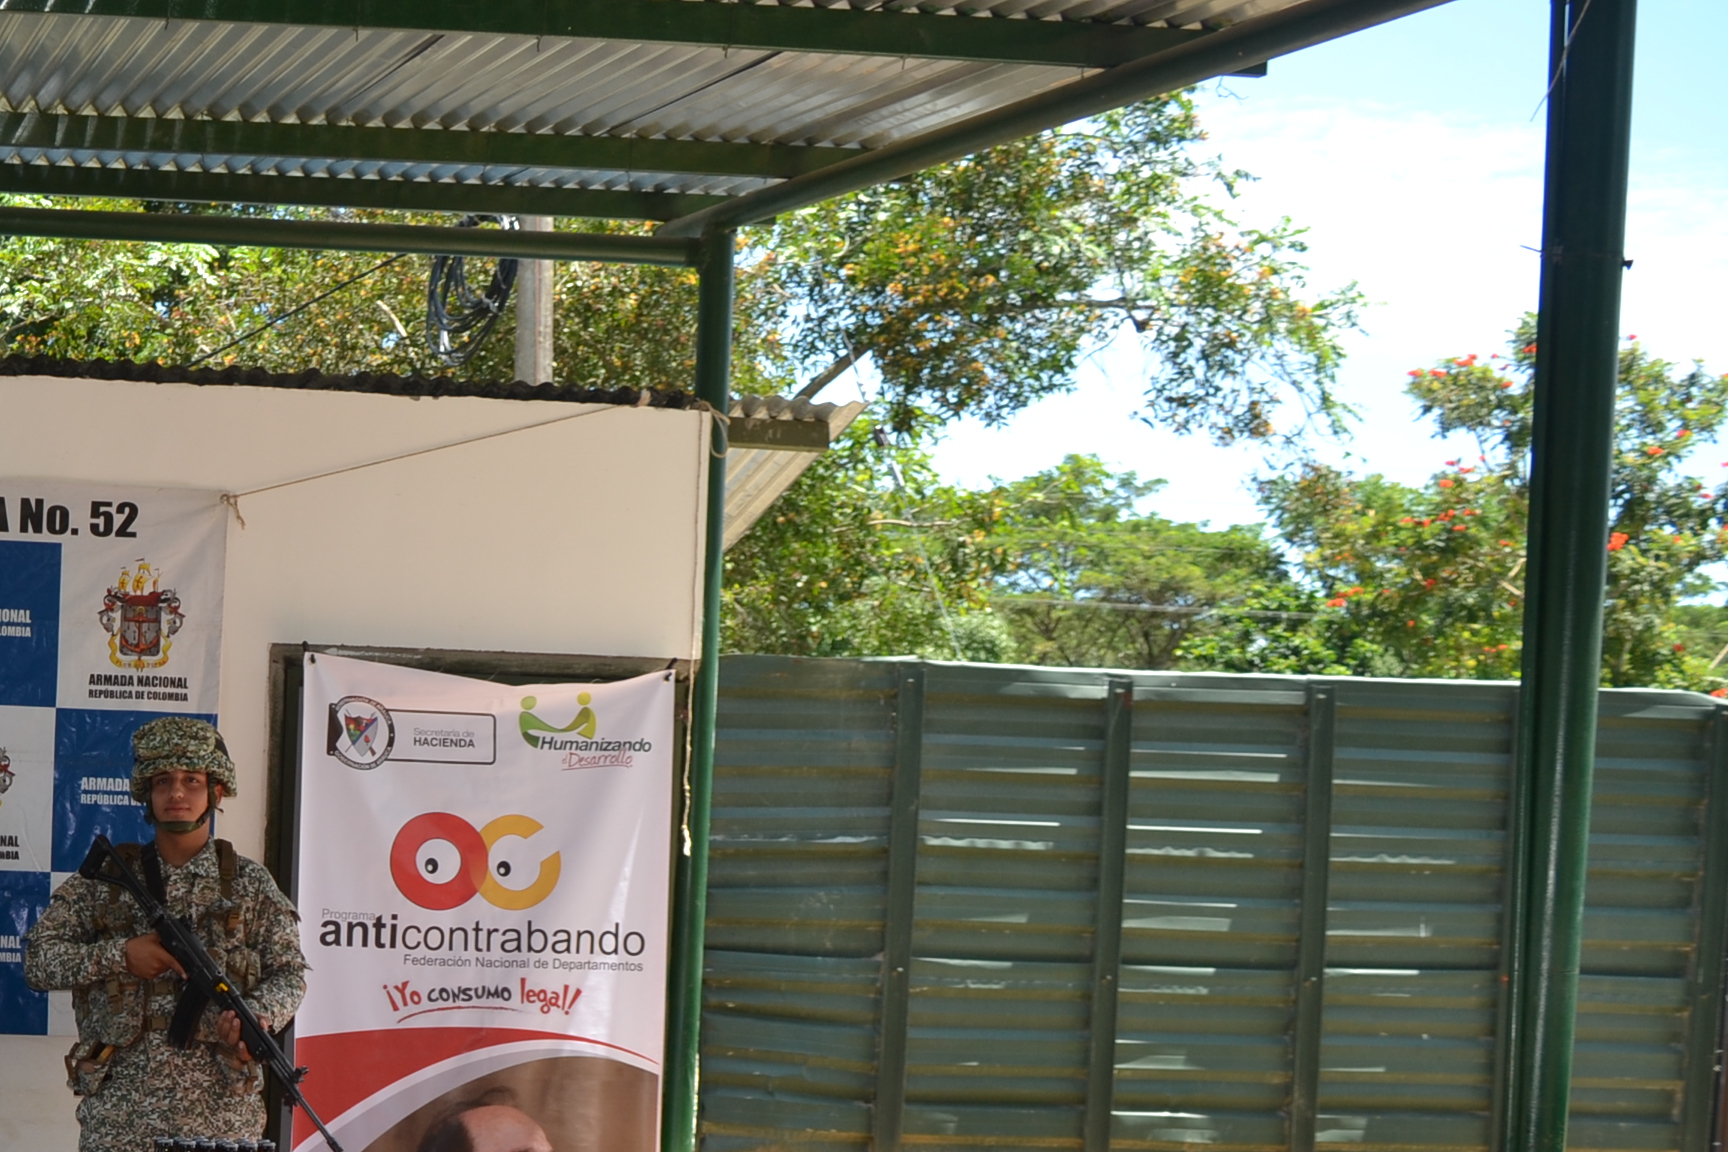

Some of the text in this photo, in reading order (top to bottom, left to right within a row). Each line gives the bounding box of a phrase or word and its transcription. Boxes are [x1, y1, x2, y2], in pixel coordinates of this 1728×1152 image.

[19, 498, 79, 536] No.
[89, 500, 139, 538] 52
[88, 673, 188, 689] ARMADA NACIONAL
[88, 688, 189, 702] REPÚBLICA DE COLOMBIA
[462, 729, 475, 738] de
[413, 736, 475, 749] HACIENDA
[539, 736, 652, 753] Humanizando
[567, 749, 633, 768] Desarrollo
[80, 776, 130, 792] ARMADA
[80, 792, 129, 806] REPÚBLICA
[321, 908, 376, 922] Programa
[319, 913, 646, 957] anticontrabando
[403, 953, 643, 972] Federación Nacional de Departamentos
[520, 977, 582, 1015] legal!
